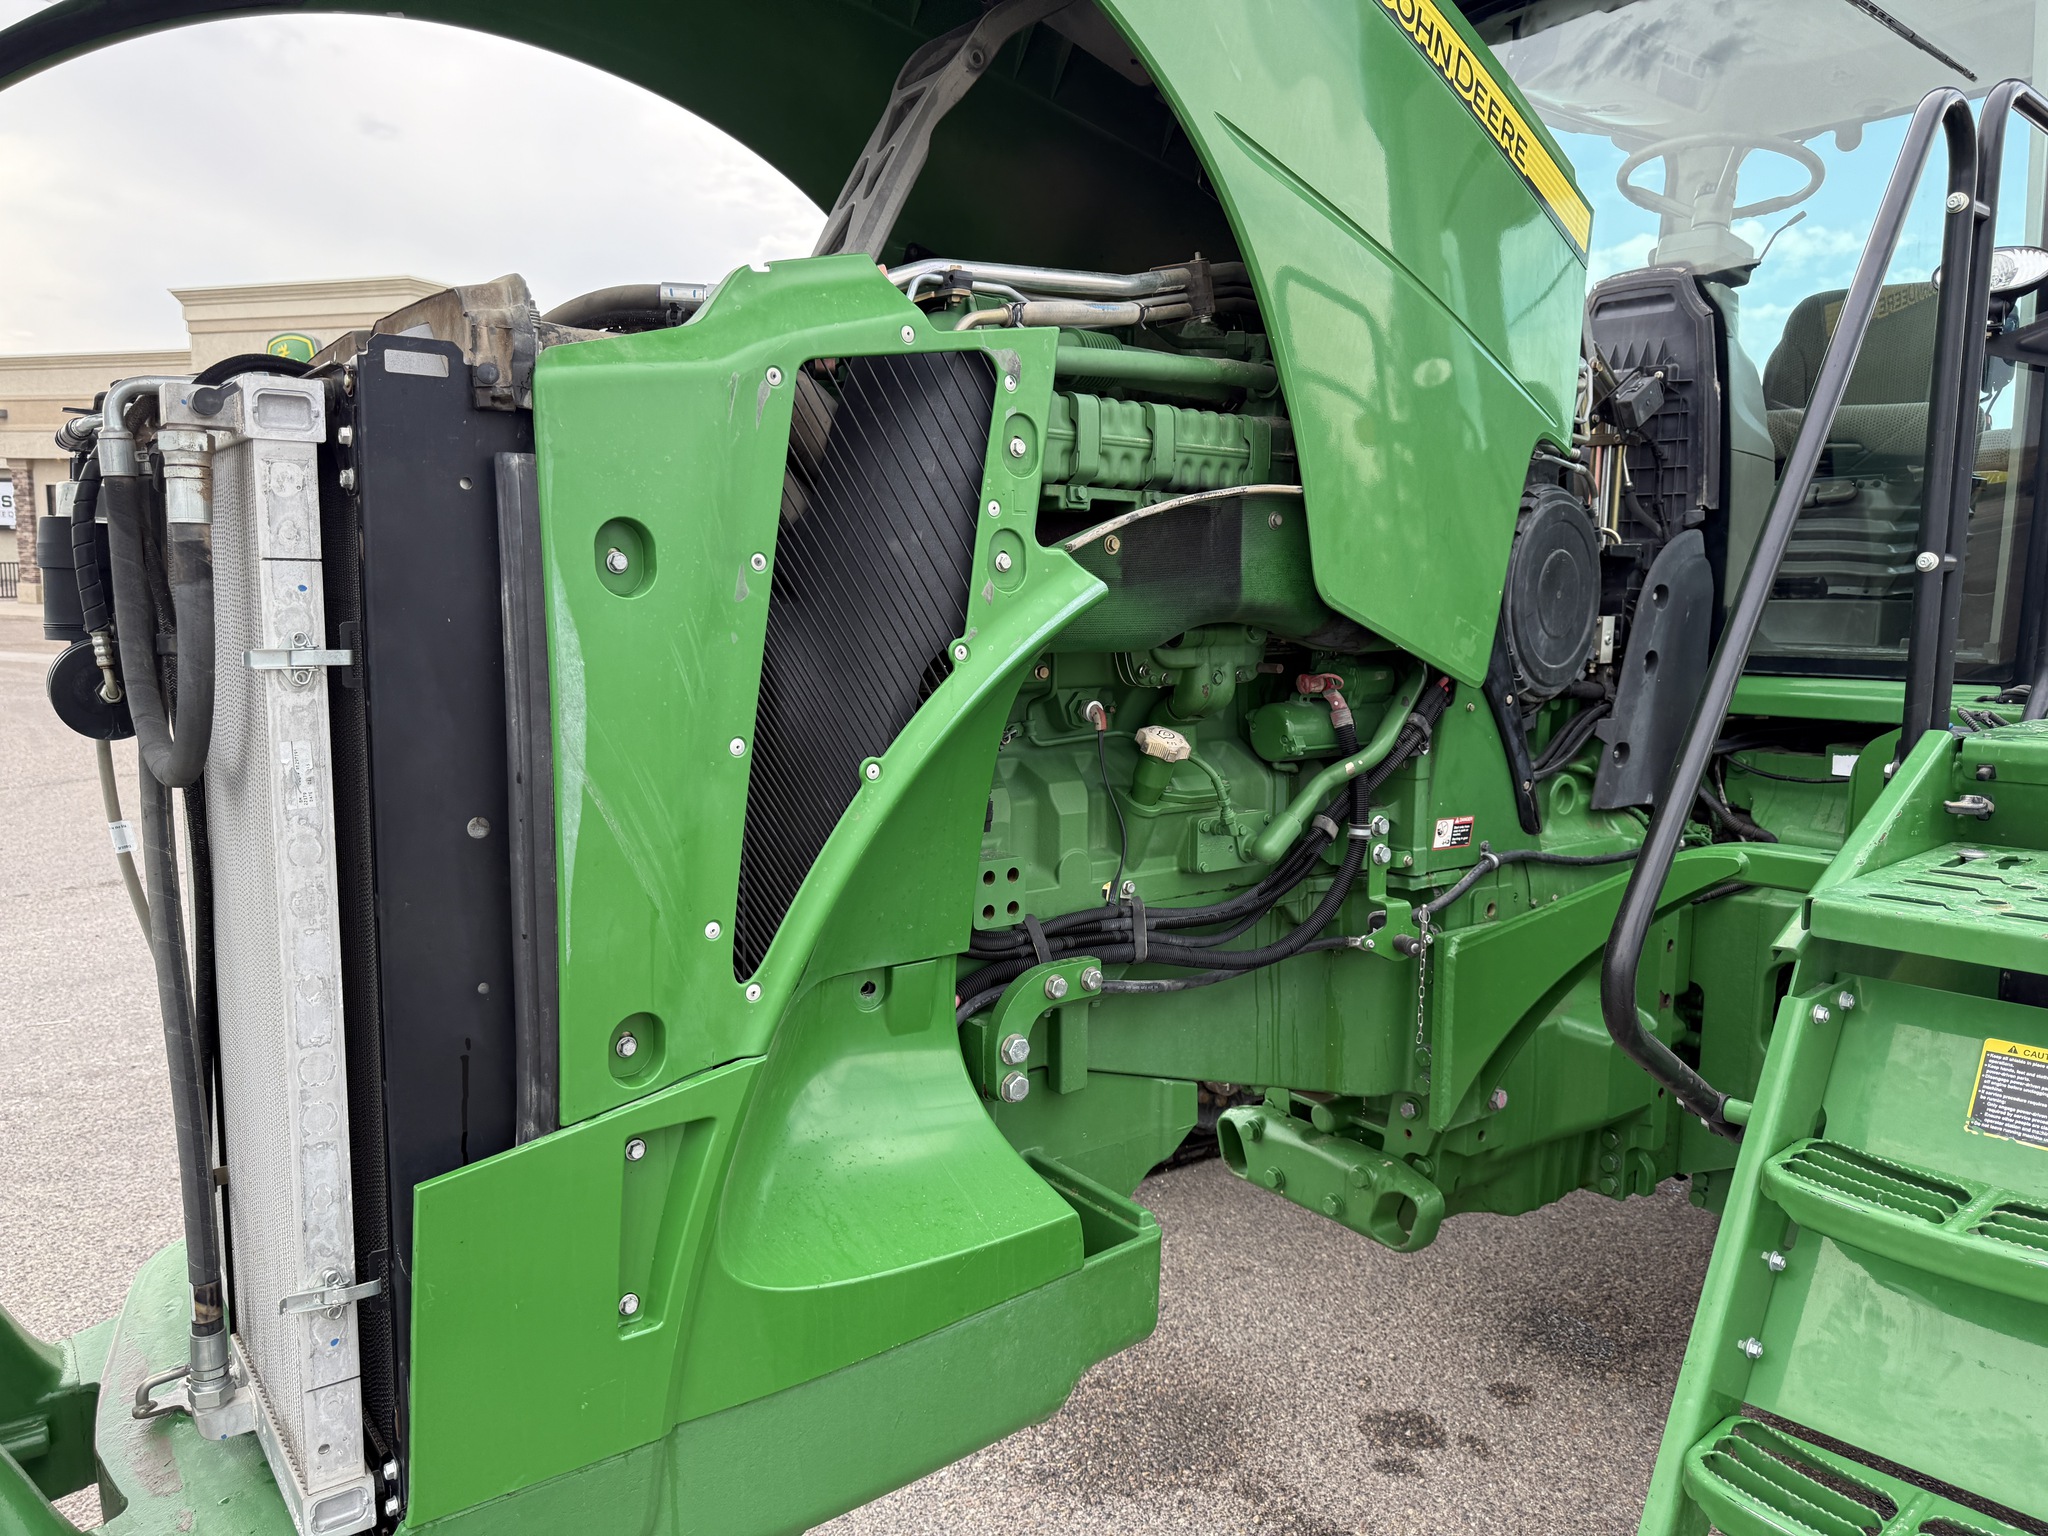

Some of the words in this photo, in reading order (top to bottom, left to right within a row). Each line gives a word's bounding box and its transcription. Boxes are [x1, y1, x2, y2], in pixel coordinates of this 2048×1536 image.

[1388, 0, 1453, 73] OHN
[2023, 1049, 2048, 1060] CAUT
[2003, 1094, 2027, 1103] procedure
[2017, 1108, 2047, 1119] power-driven
[2015, 1119, 2031, 1127] people
